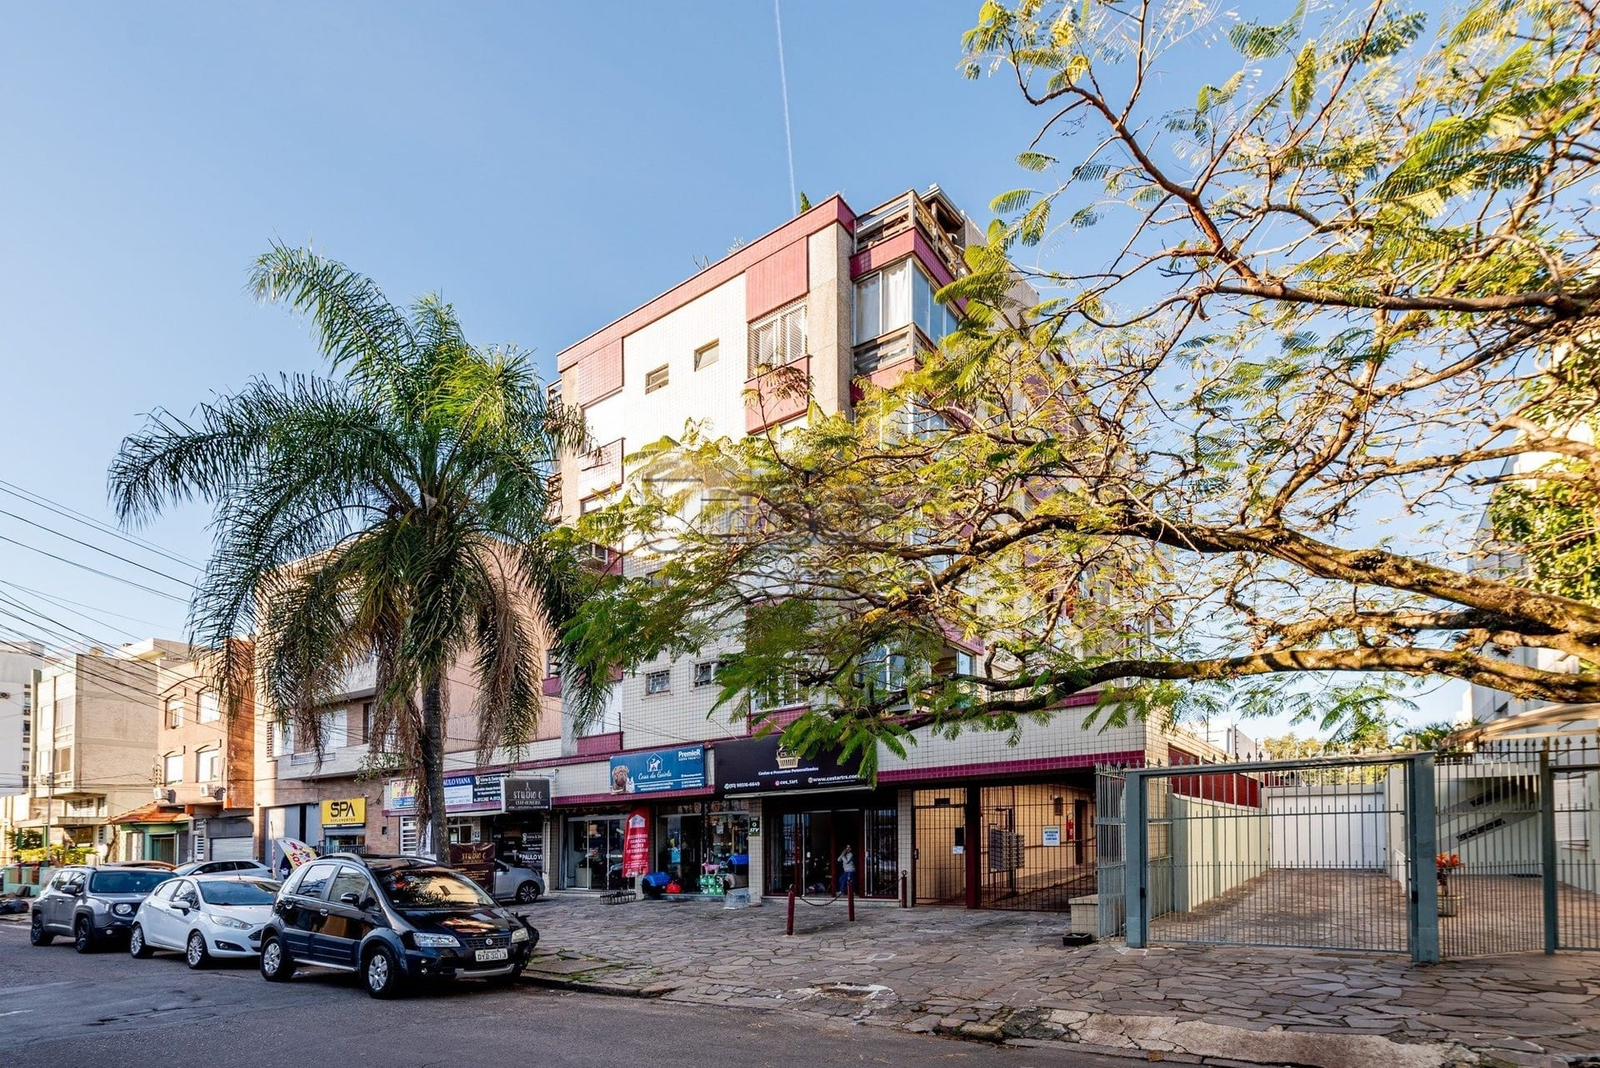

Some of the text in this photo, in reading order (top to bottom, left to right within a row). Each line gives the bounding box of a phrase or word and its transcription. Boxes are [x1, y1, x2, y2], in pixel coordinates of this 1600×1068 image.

[443, 778, 455, 786] AULO
[513, 791, 536, 799] STUDIO
[330, 801, 355, 817] SPA
